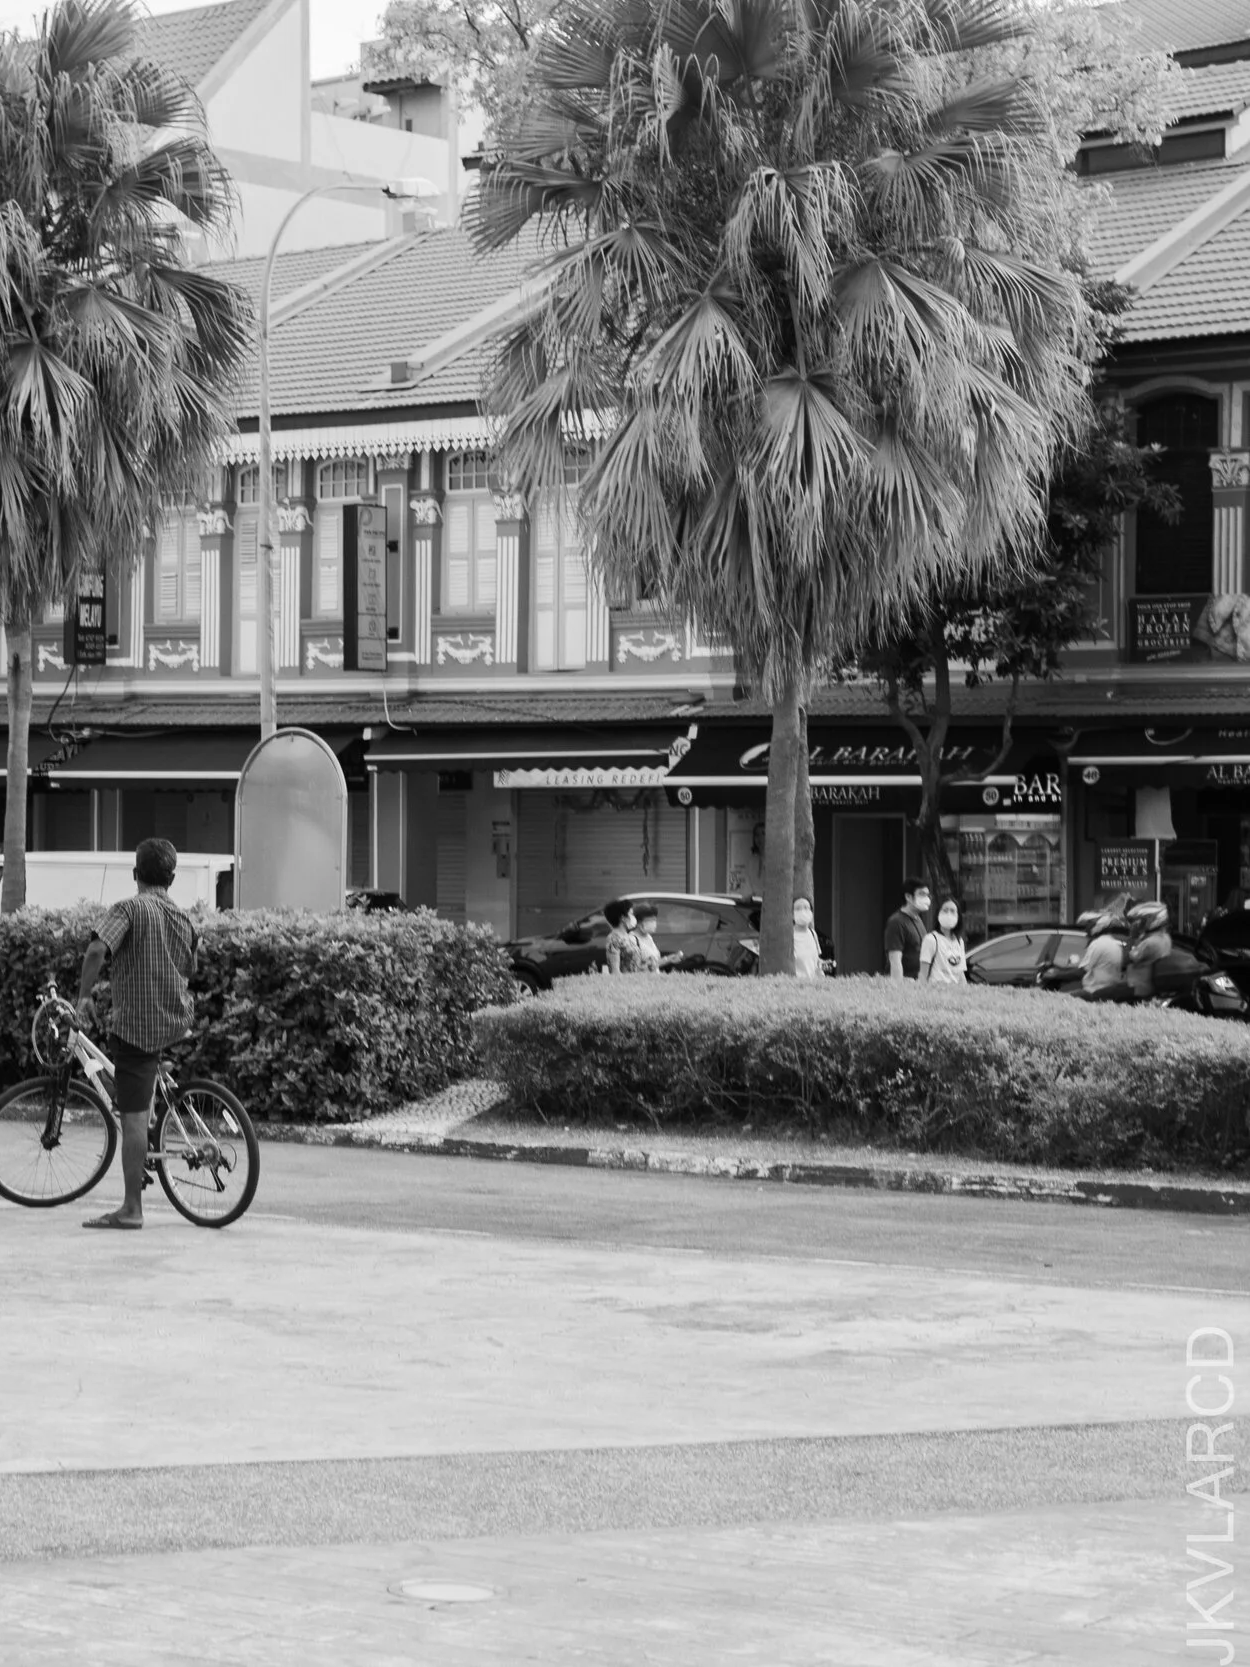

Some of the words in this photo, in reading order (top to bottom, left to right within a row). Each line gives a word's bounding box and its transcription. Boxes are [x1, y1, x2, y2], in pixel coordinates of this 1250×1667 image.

[1137, 612, 1190, 624] HALAL
[1137, 623, 1190, 635] FROZEN
[833, 745, 973, 761] BARAH
[546, 774, 604, 786] LEASING
[1014, 773, 1062, 796] BAR
[1101, 857, 1148, 867] PREMIUM
[1101, 866, 1148, 876] DATES
